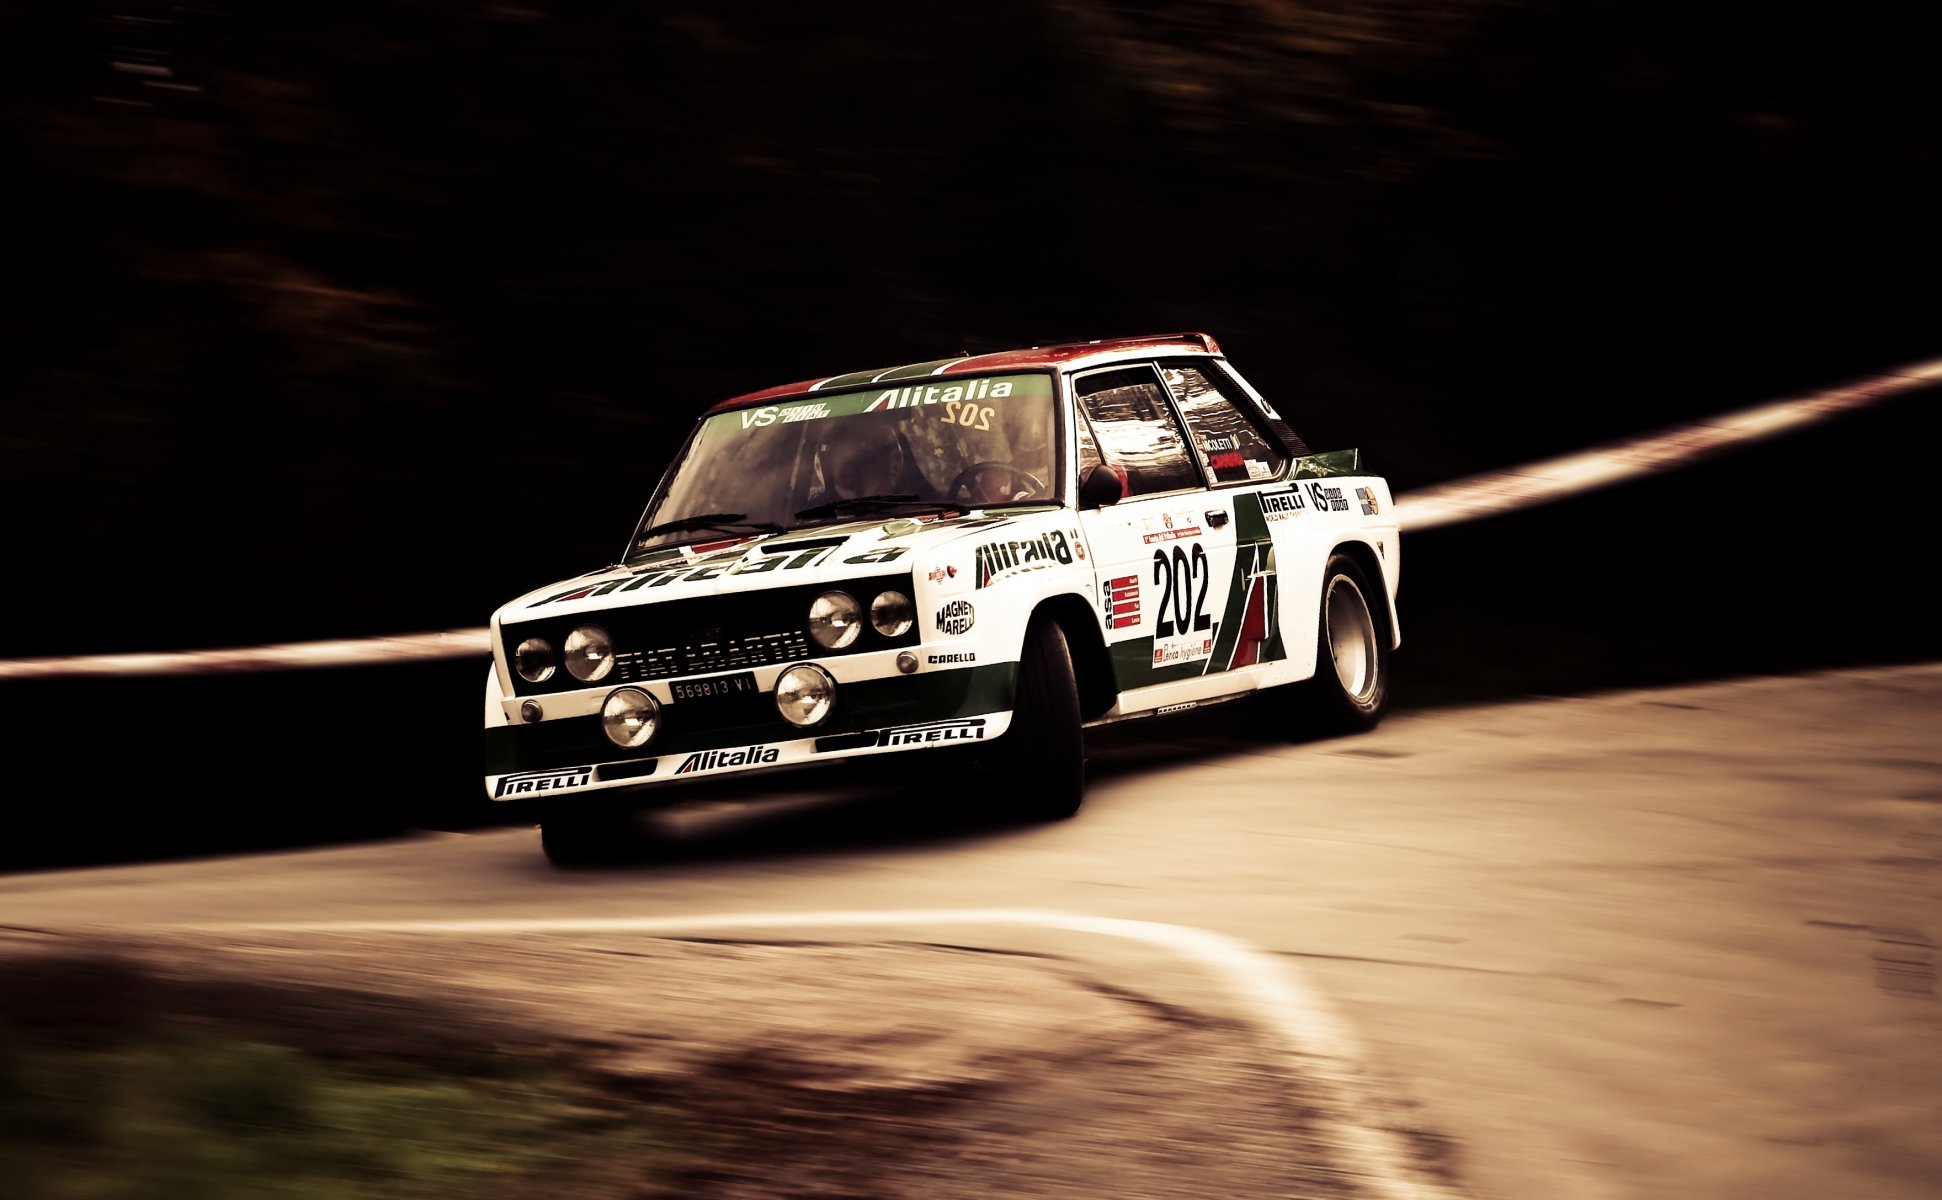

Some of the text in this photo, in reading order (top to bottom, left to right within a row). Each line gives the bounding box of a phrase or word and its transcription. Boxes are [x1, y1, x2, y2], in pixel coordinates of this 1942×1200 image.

[862, 379, 1014, 413] Alitalia
[741, 406, 779, 430] VS
[1257, 483, 1305, 513] PIRELLI
[1304, 482, 1328, 512] VS
[1153, 543, 1210, 639] 202
[616, 630, 808, 679] FIAT ABARTH
[928, 652, 976, 664] CARELLO
[675, 681, 729, 699] 569813
[876, 718, 986, 747] PIRELLI
[674, 746, 779, 775] Alitalia
[495, 766, 592, 798] PIRELLI
